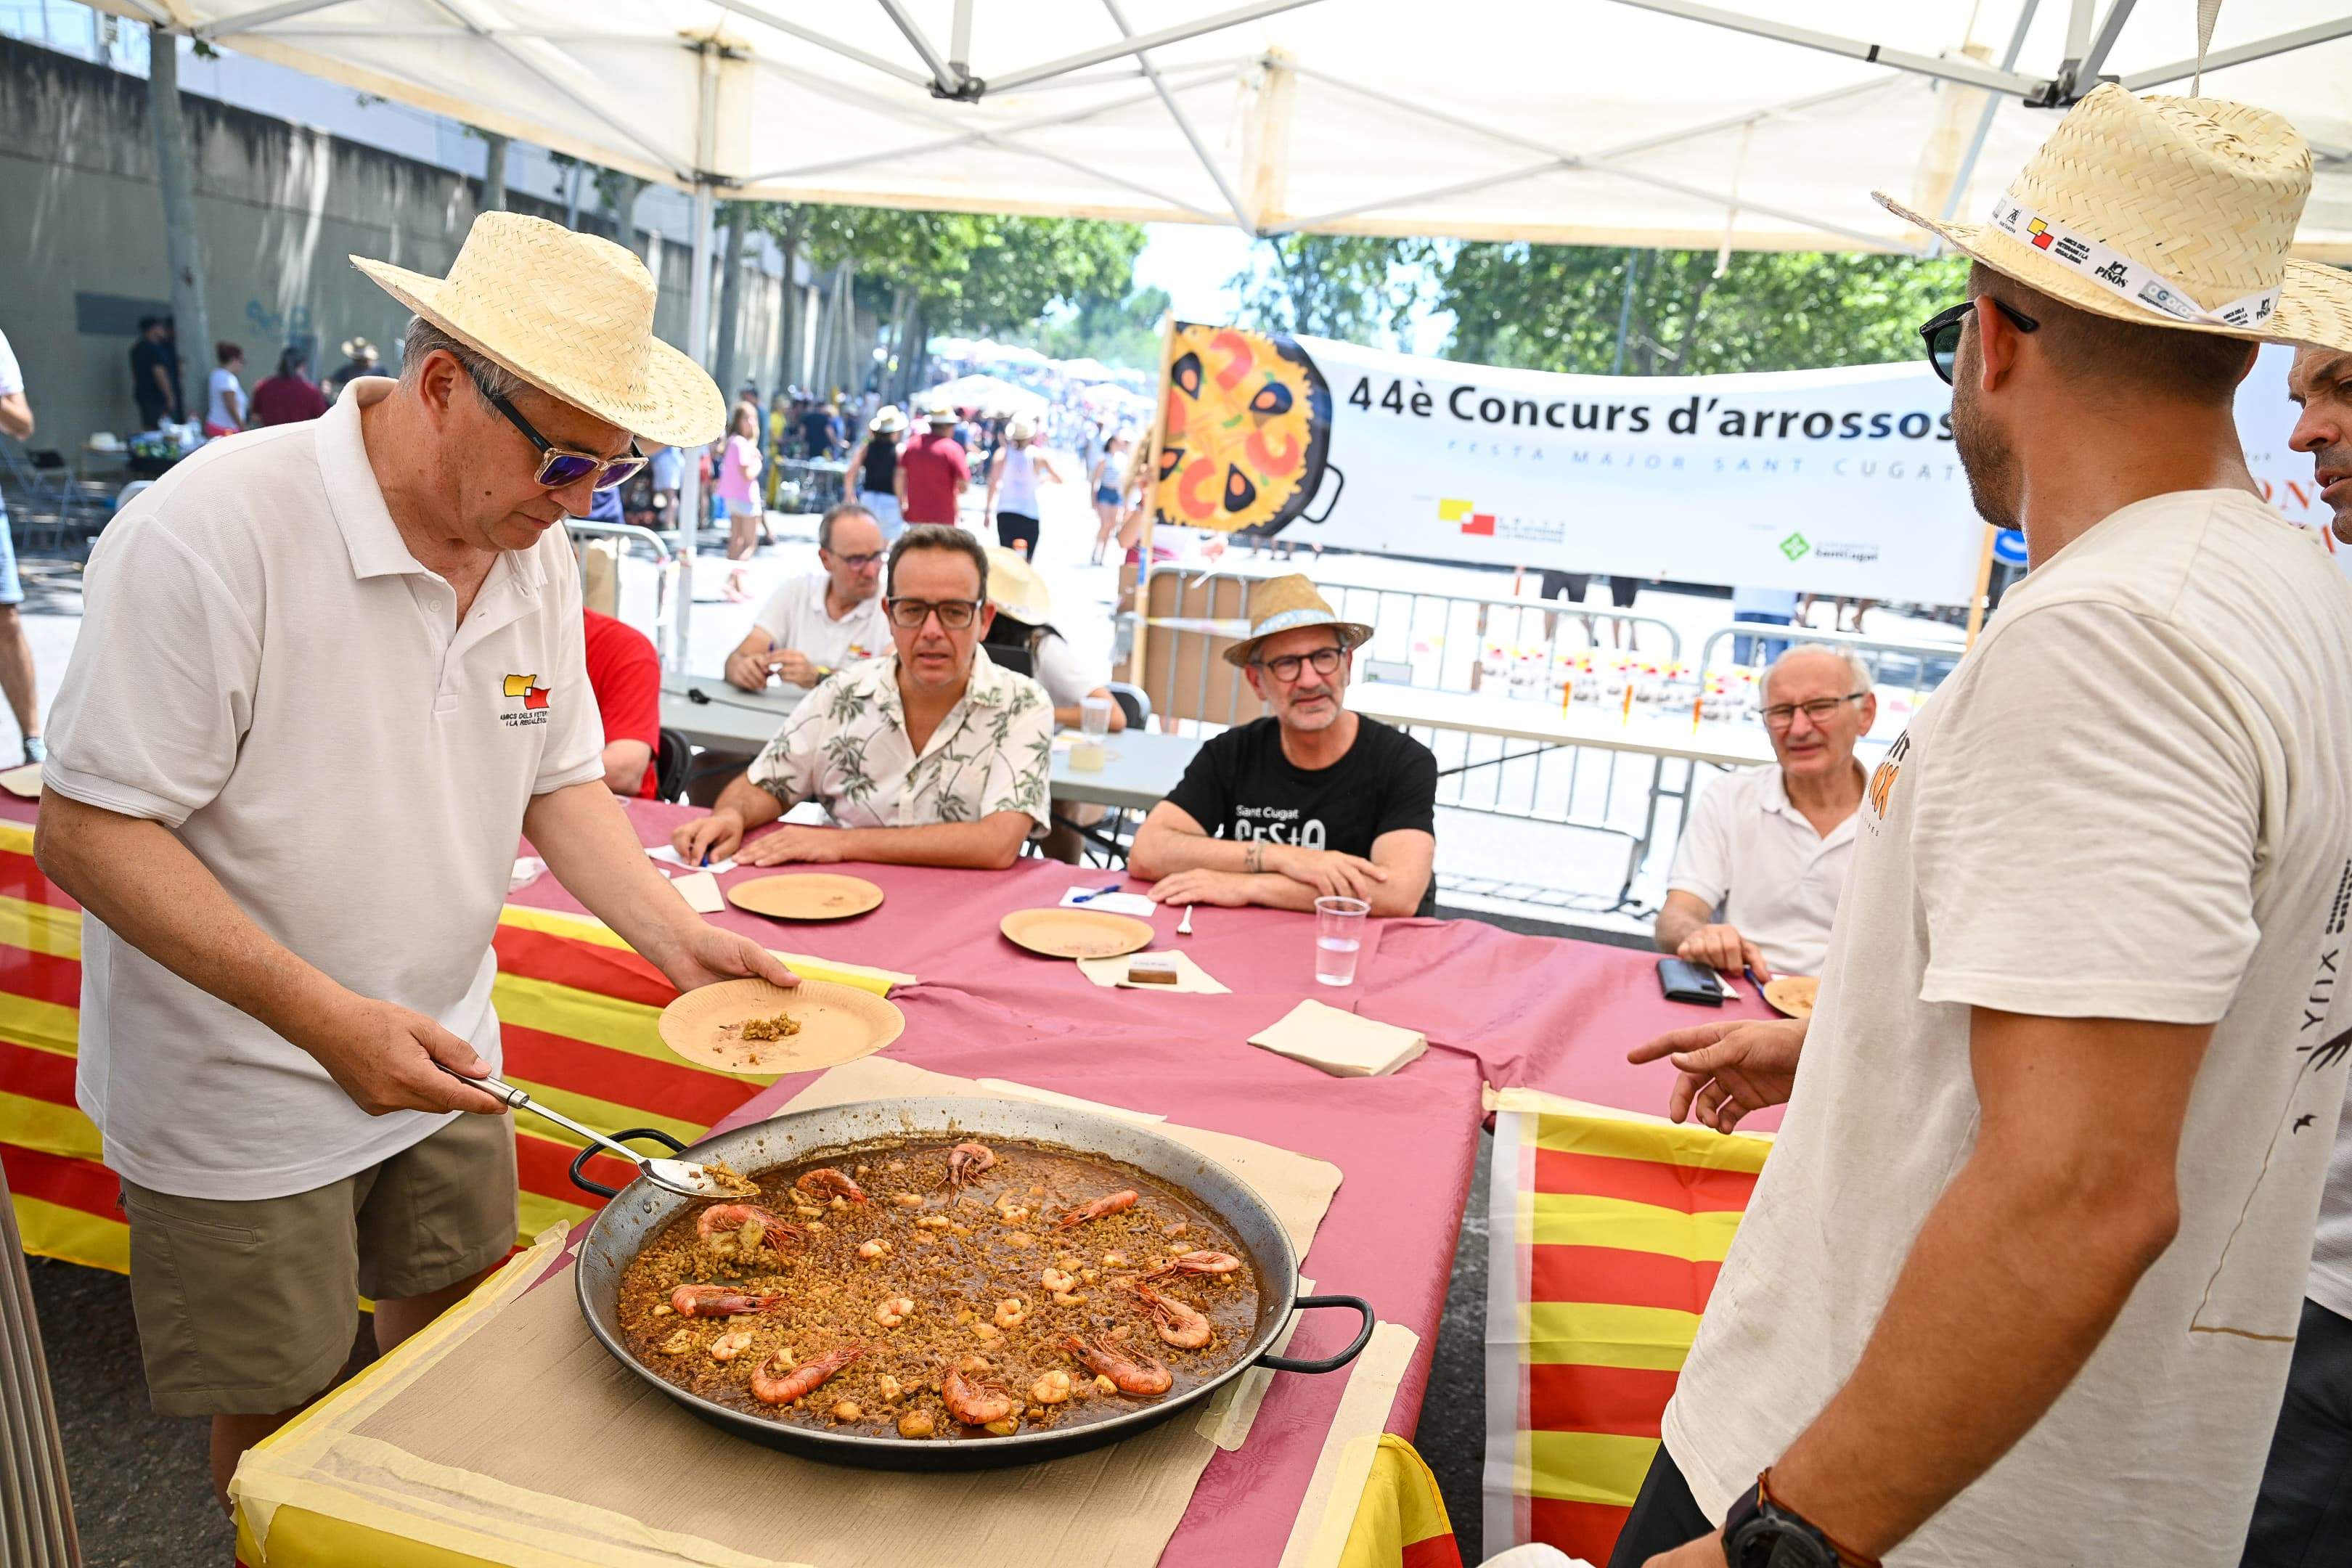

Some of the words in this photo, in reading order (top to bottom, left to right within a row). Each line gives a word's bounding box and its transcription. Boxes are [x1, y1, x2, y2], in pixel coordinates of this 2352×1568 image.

[2094, 266, 2128, 288] PISOS
[1348, 376, 1433, 417] 44è
[1448, 385, 1651, 433] Concurs
[1447, 440, 1543, 461] FESTA
[1571, 450, 1685, 470] MAJOR
[1714, 457, 1804, 473] SANT
[1833, 458, 1959, 481] CUGAT
[1236, 804, 1262, 817] Sant
[1262, 807, 1299, 821] Cugat
